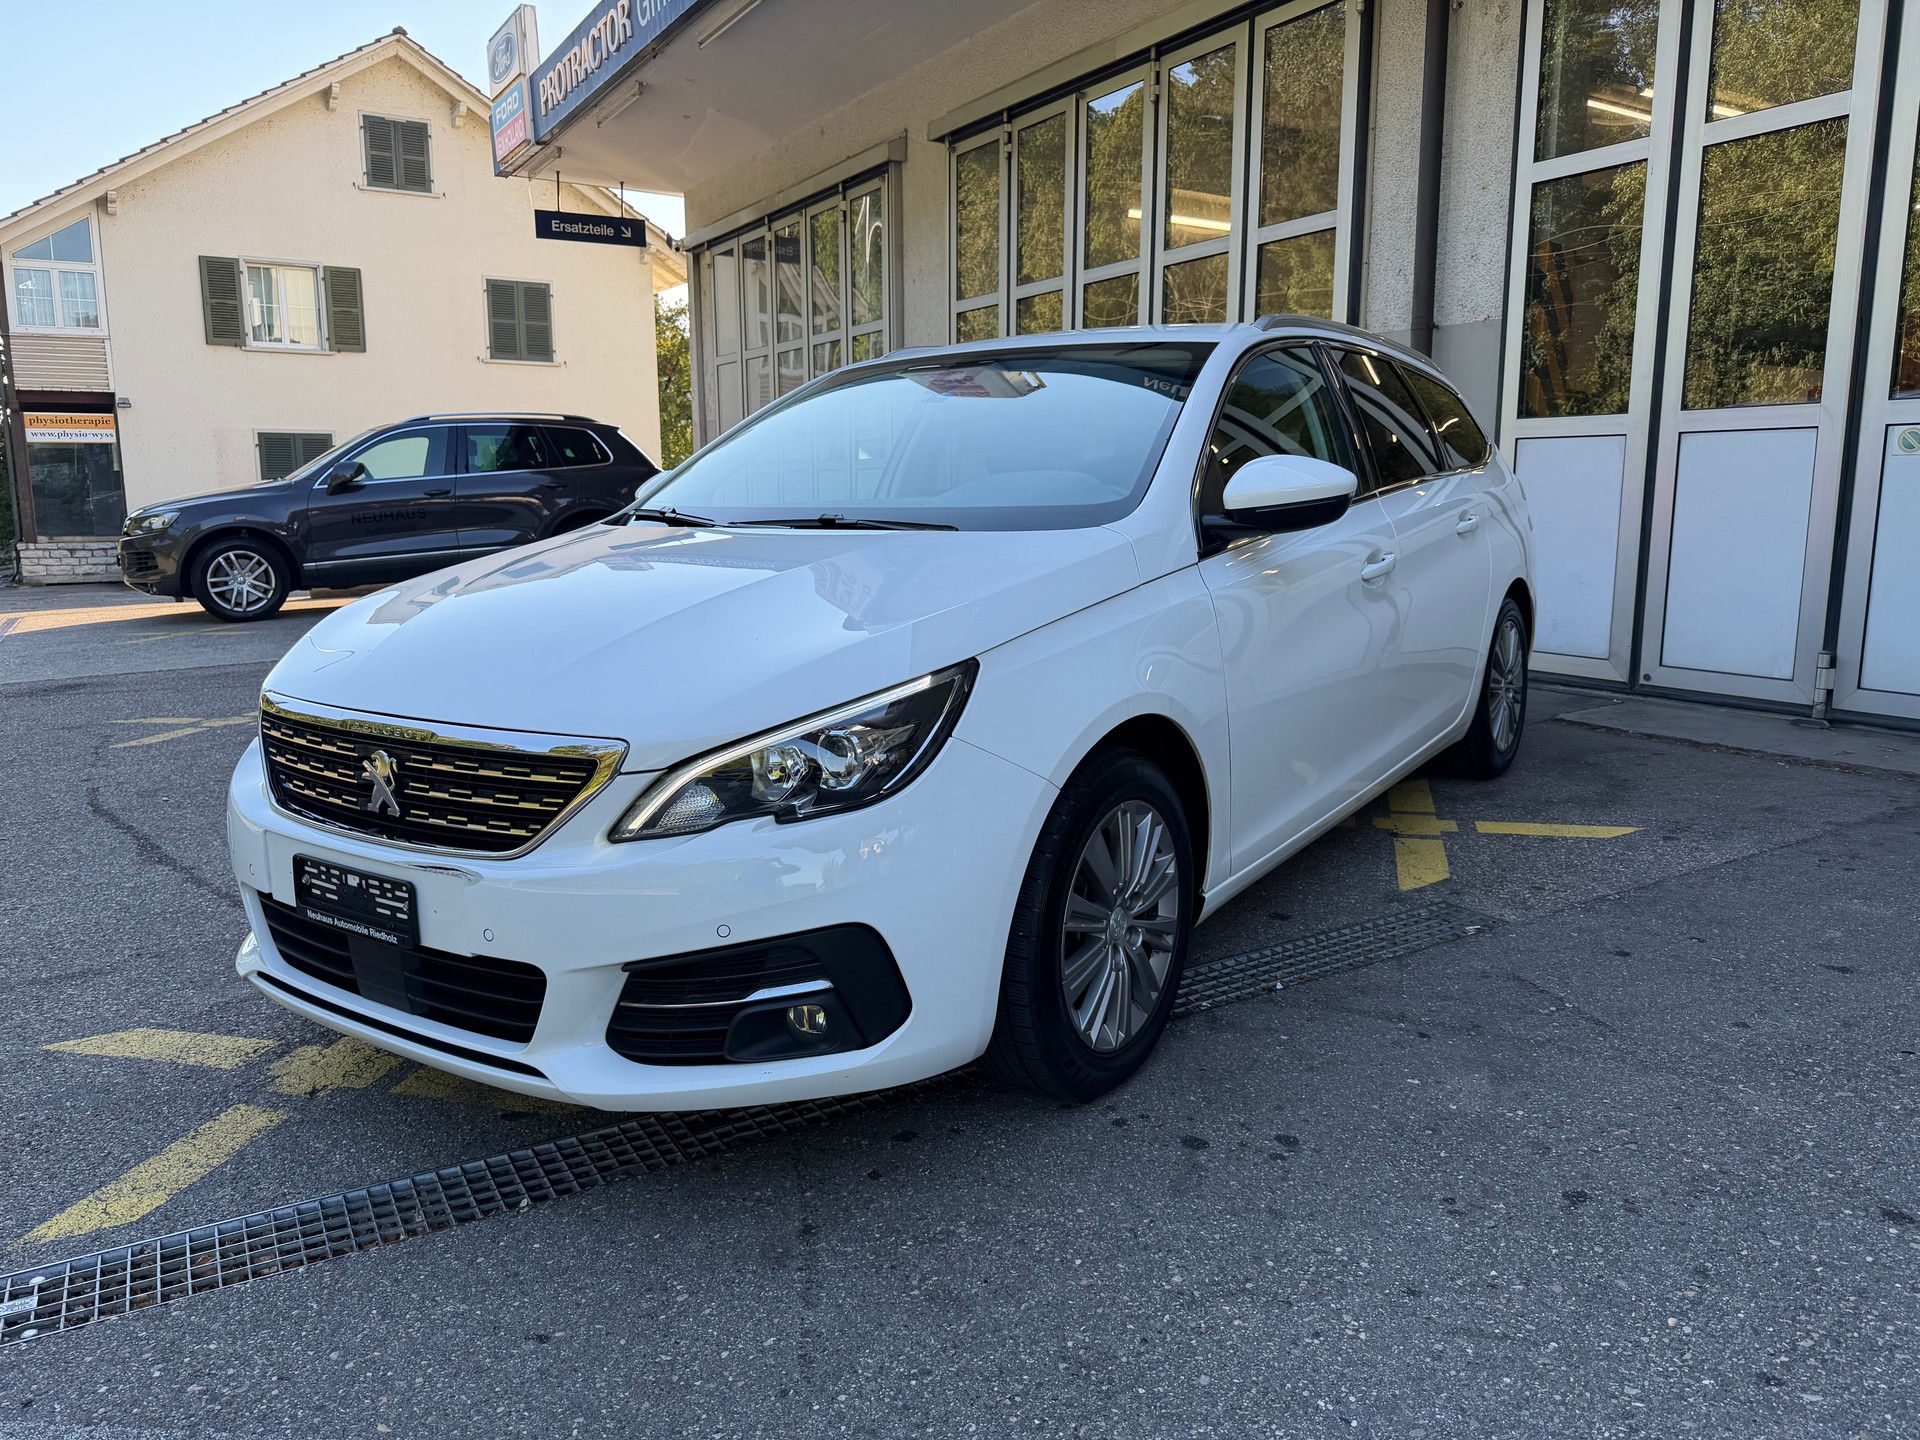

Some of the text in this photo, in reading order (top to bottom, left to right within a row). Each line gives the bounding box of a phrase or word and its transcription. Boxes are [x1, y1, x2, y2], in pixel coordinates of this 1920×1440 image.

[540, 0, 632, 117] PROTRACTOR
[496, 90, 519, 125] FORD
[551, 219, 615, 236] Ersatzteile
[28, 416, 111, 426] physiotherapie
[30, 430, 114, 440] www.physio-wyss
[351, 508, 427, 524] NEUHAUS
[353, 721, 424, 739] PEUGEOT
[306, 909, 398, 944] Neuhaus Automobile Riedholz
